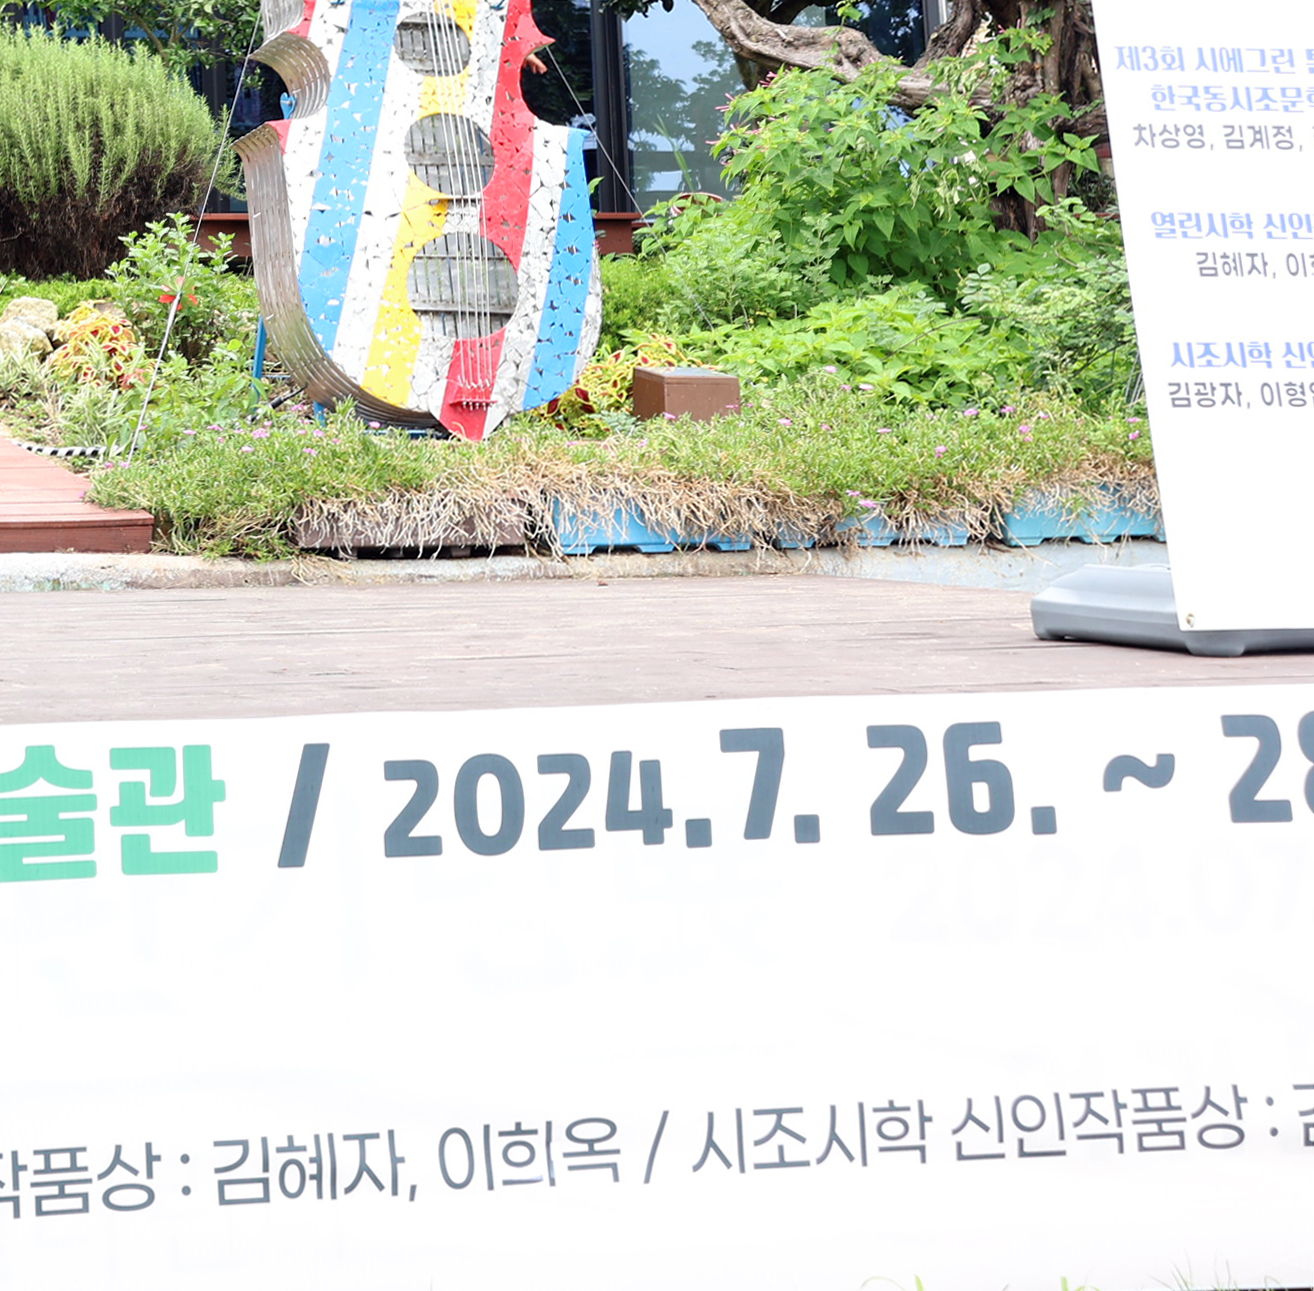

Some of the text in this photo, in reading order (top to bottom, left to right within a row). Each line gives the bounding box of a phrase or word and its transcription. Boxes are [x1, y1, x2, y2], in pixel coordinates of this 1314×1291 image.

[1114, 45, 1186, 72] 제3회
[1195, 47, 1296, 74] 시에그린
[1133, 123, 1303, 152] 차상영, 김계정,
[1150, 211, 1314, 240] 열린시학 신인
[1195, 252, 1314, 279] 김혜자, 이
[1170, 340, 1273, 369] 시조시학
[1167, 382, 1250, 409] 김광자,
[384, 728, 820, 857] 2024.7.
[867, 722, 1056, 835] 26.
[214, 1130, 416, 1205] 김혜자,
[439, 1118, 620, 1190] 이희옥
[693, 1101, 932, 1173] 시조시학
[953, 1086, 1247, 1160] 신인작품상
